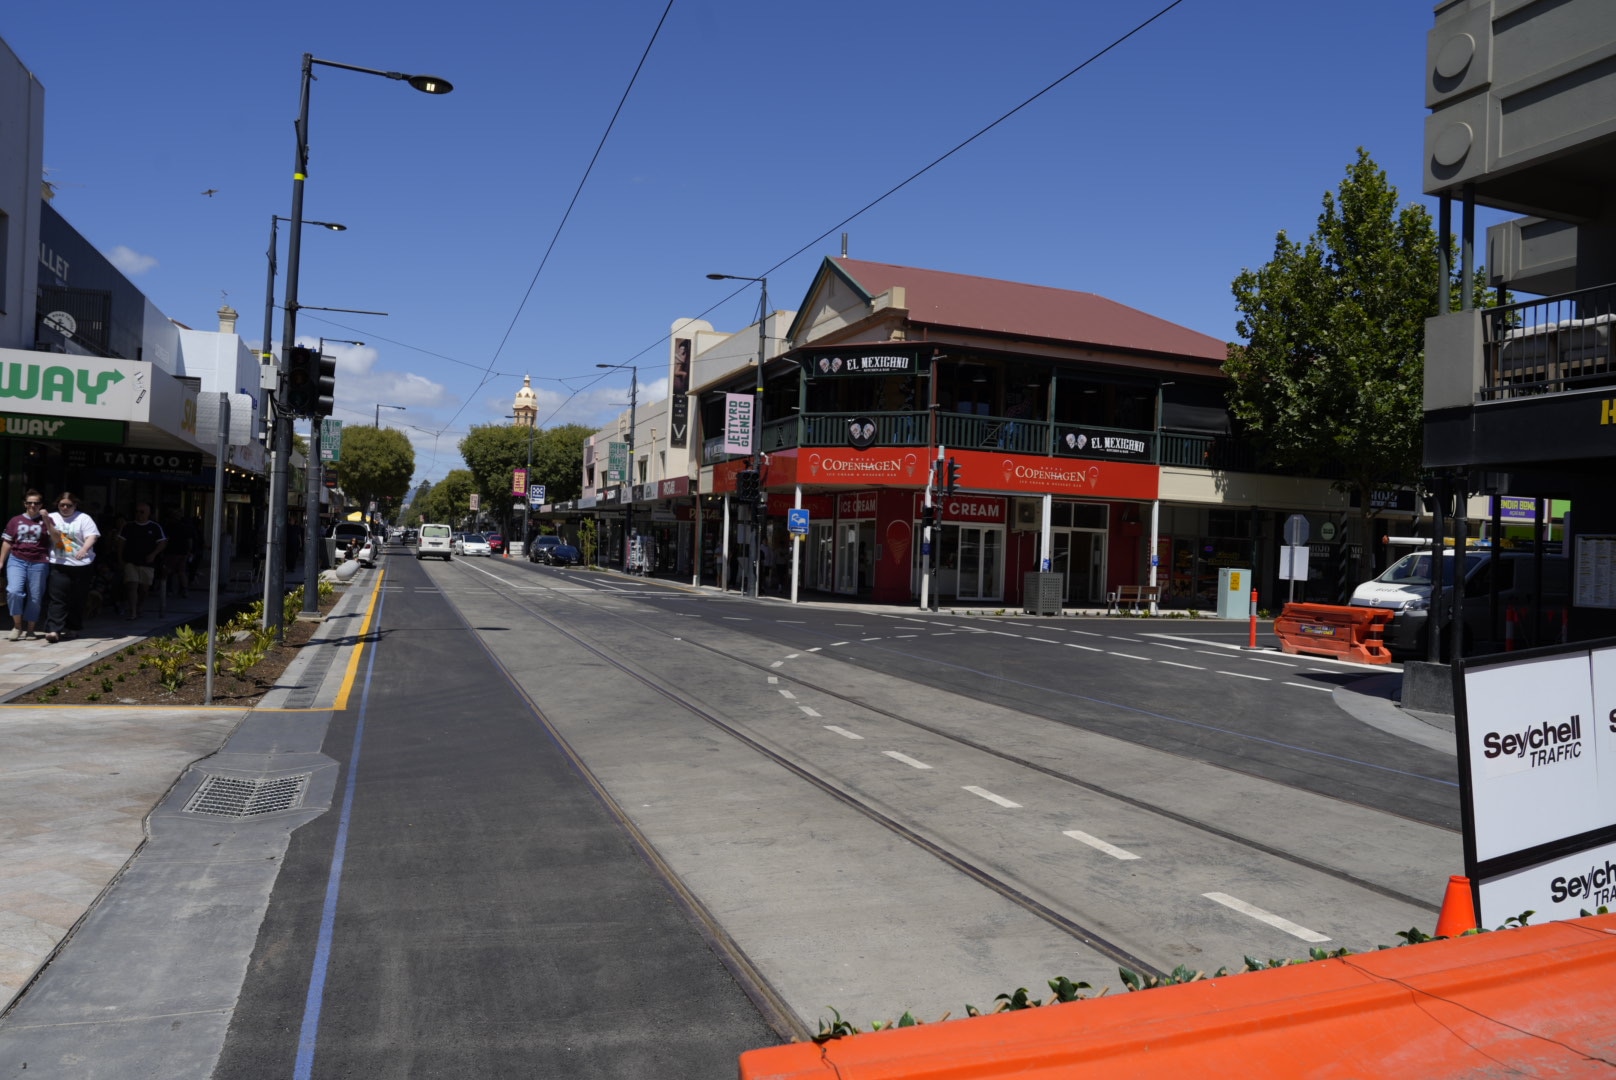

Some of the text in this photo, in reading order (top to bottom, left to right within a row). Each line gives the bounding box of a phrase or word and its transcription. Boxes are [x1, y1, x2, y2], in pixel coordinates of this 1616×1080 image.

[40, 242, 70, 282] LLET
[846, 356, 909, 371] EL MEXICANO
[672, 423, 687, 440] V
[738, 401, 751, 448] GLENELG
[1091, 436, 1145, 453] EL MEXICANO
[103, 451, 180, 468] TATTOO
[840, 498, 877, 514] ICE CREAM
[948, 502, 1000, 518] CREAM
[1483, 714, 1581, 759] Seychell
[1529, 741, 1582, 768] TRAFFIC
